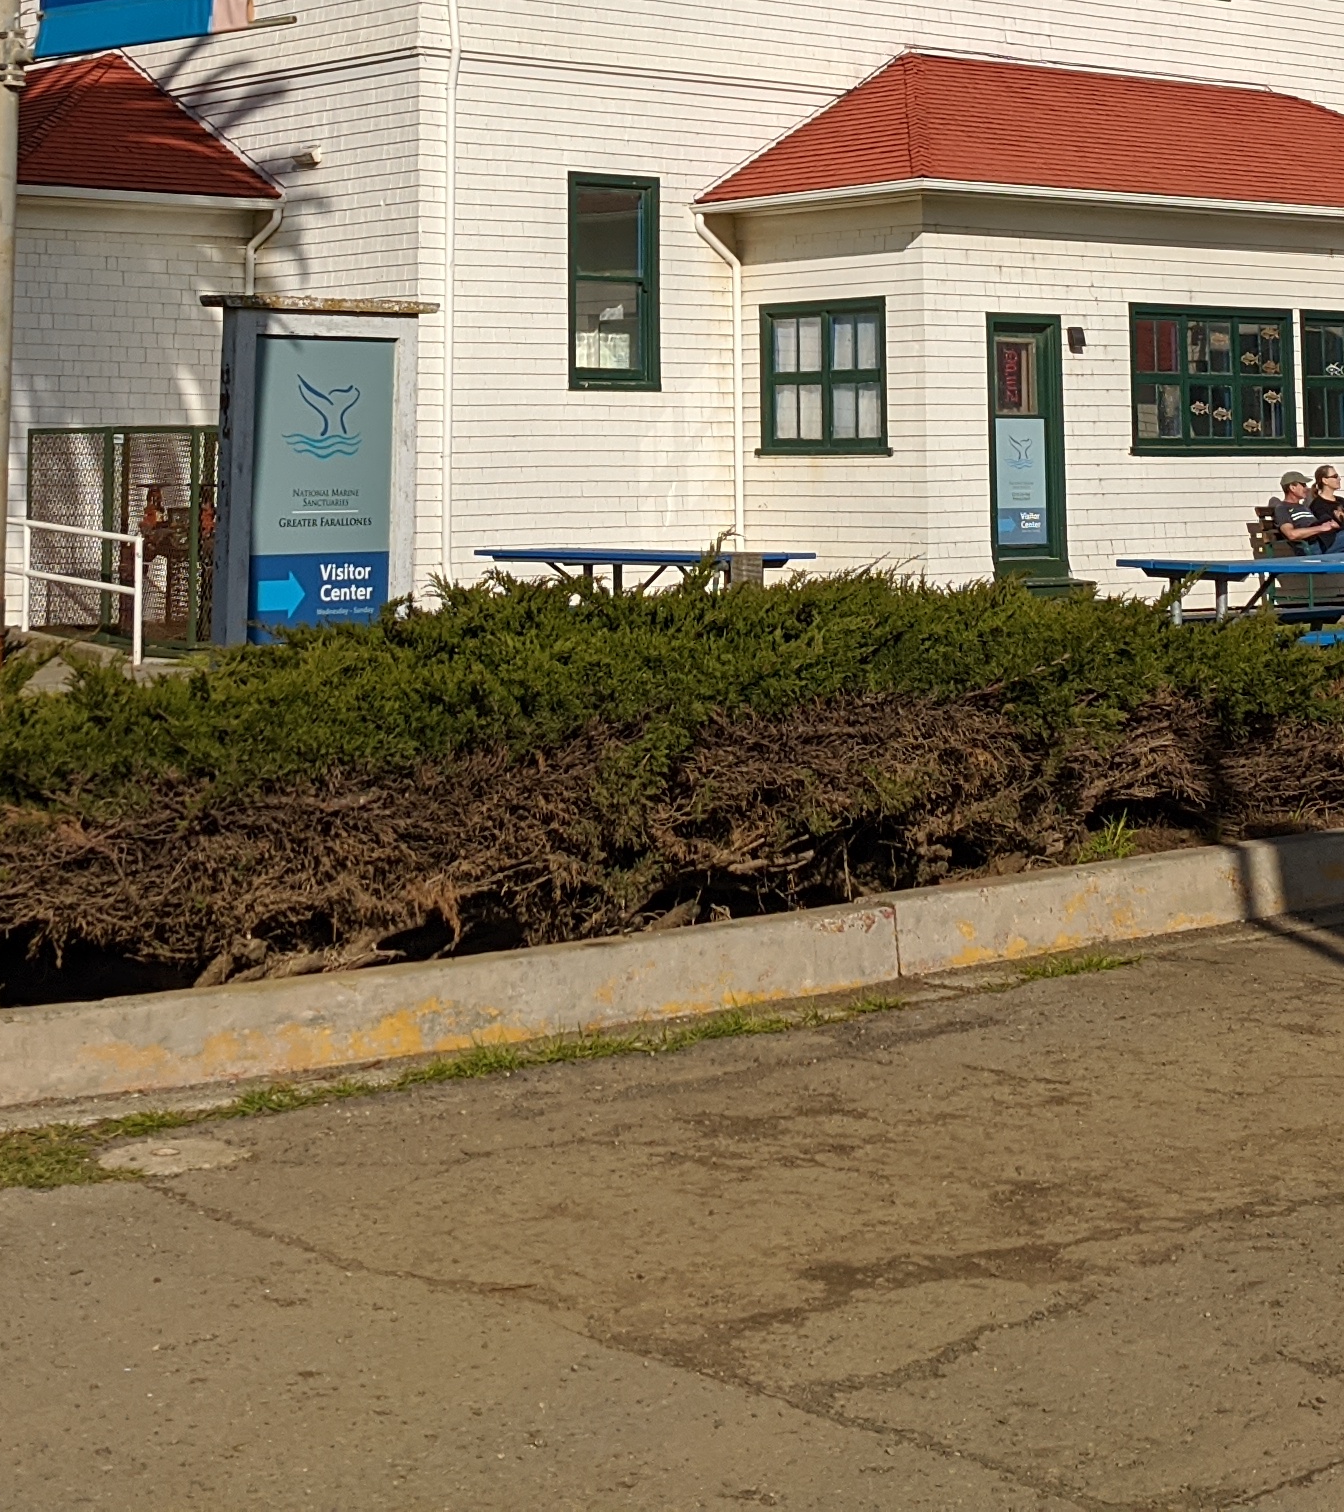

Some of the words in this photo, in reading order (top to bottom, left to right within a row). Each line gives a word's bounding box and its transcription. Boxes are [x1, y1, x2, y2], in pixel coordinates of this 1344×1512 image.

[293, 489, 329, 497] NATIONAL
[331, 489, 359, 497] MARINE
[302, 498, 349, 507] SANCTUARIES
[1019, 512, 1040, 520] Visitor
[279, 518, 318, 528] GREATER
[320, 517, 372, 527] FARALLONES
[1020, 521, 1042, 529] Center
[319, 563, 372, 581] Visitor
[320, 584, 373, 601] Center
